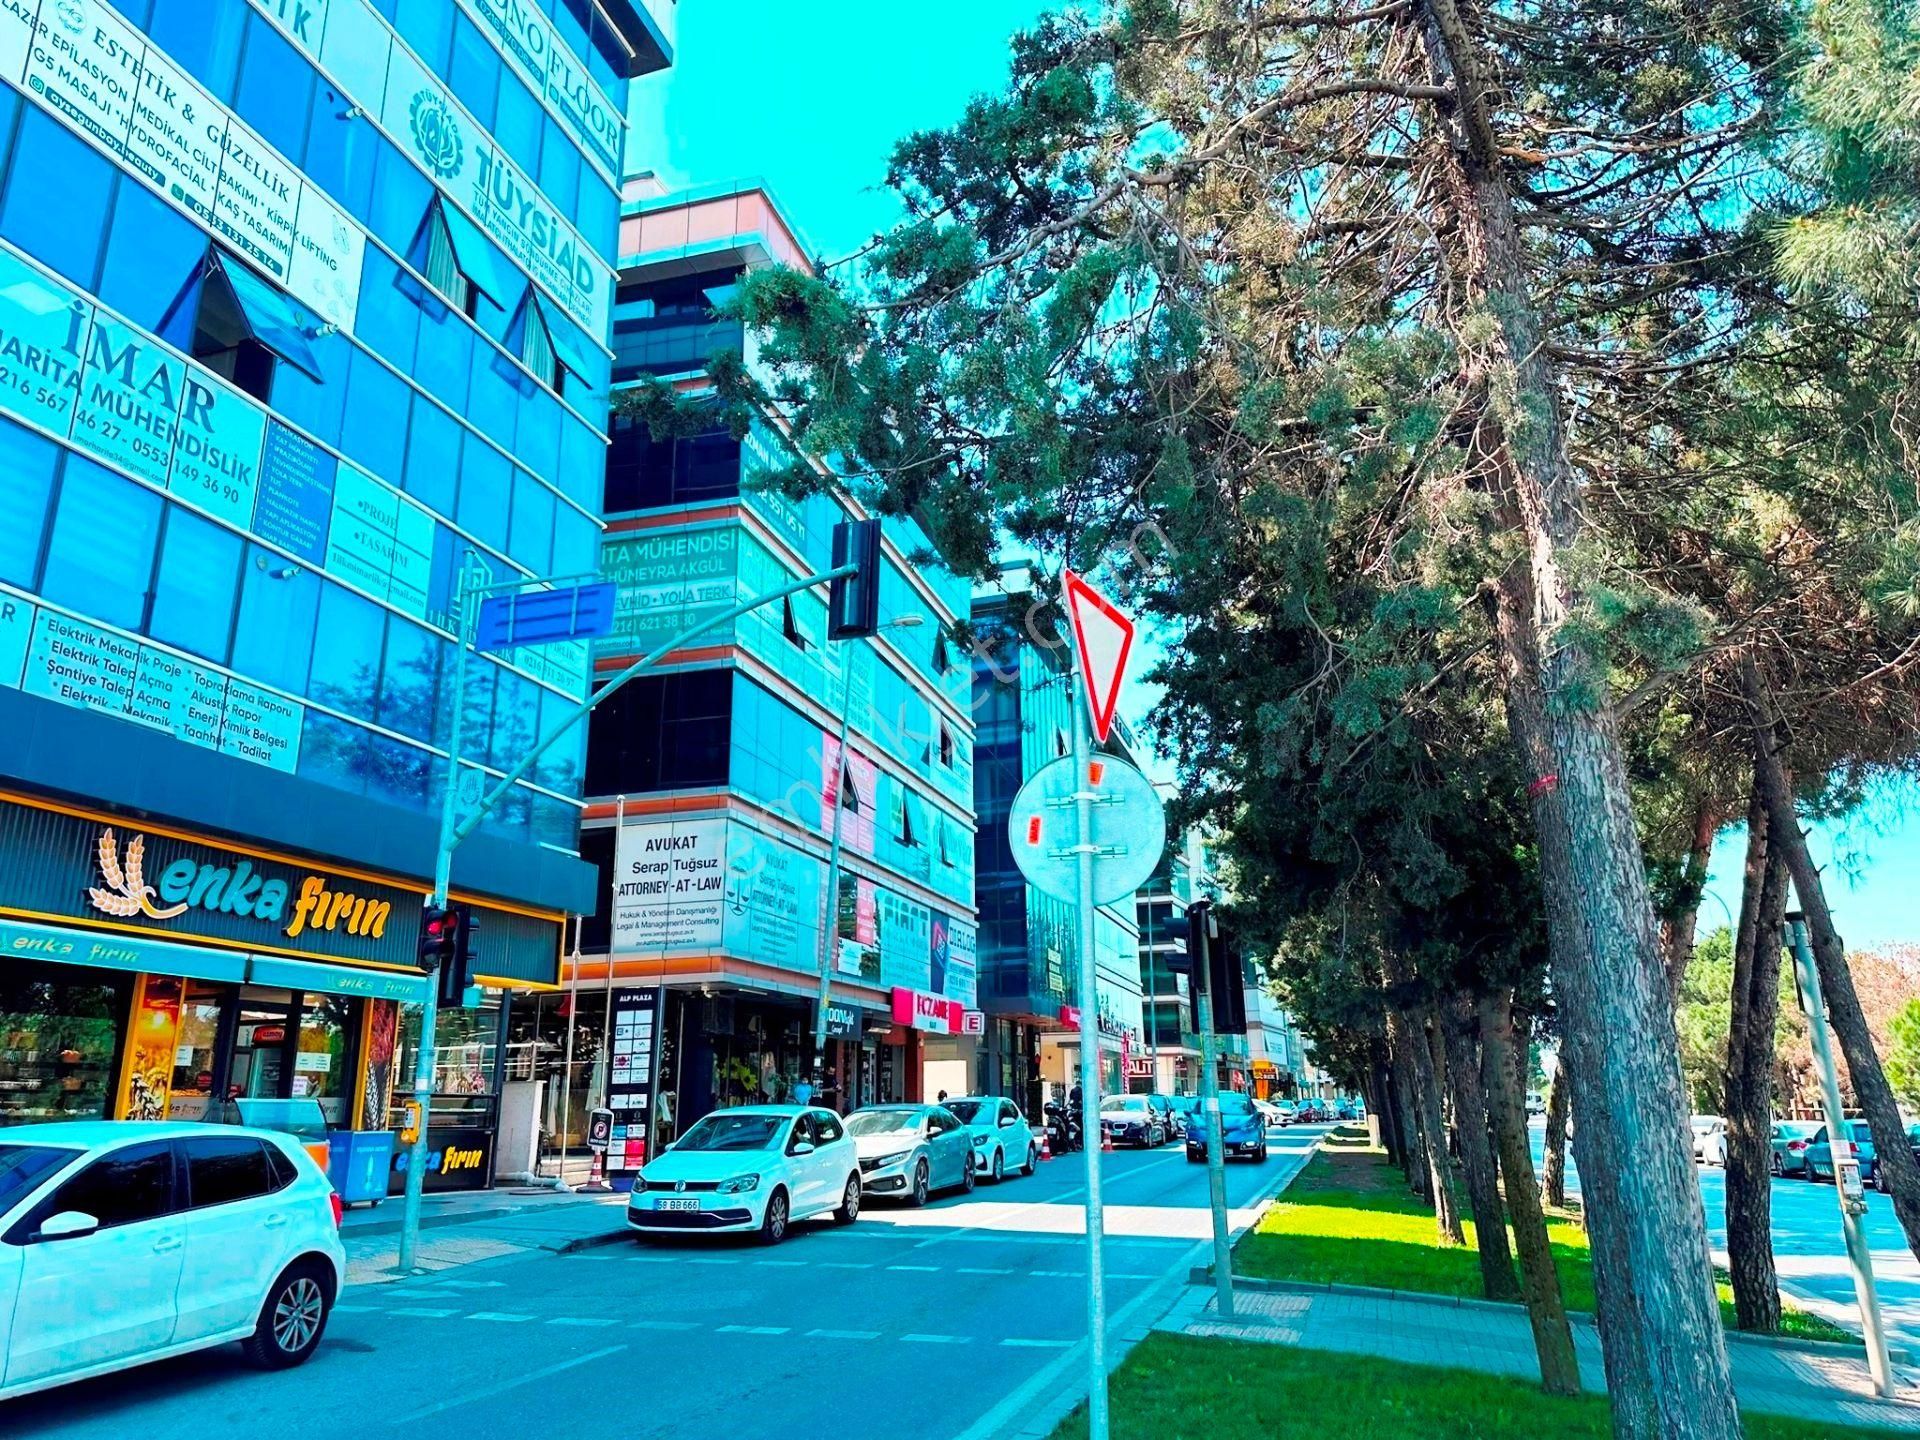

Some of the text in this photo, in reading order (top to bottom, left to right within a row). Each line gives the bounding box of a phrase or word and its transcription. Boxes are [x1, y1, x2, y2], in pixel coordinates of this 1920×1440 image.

[93, 26, 290, 203] ESTETİK & GÜZELLİK
[550, 47, 618, 153] FLOOR
[1, 0, 48, 39] LAZER
[52, 33, 128, 101] EPİLASYON
[136, 101, 190, 154] MEDİKAL
[193, 148, 218, 175] CİLT
[218, 170, 258, 207] BAKIMI
[267, 207, 300, 242] KİRPİK
[302, 235, 338, 271] LİFTİNG
[33, 47, 291, 257] G5 MASAJI HYDROFACİAL KAŞ TASARIMI
[475, 146, 594, 294] TÜYSİAD
[60, 299, 216, 434] İMAR
[36, 387, 68, 413] 567
[76, 410, 96, 431] 46
[100, 419, 121, 441] 27
[132, 437, 169, 467] 0553
[174, 459, 199, 482] 149
[203, 472, 218, 494] 36
[223, 482, 239, 503] 90
[91, 383, 251, 486] MÜHENDİSLİK
[635, 528, 736, 562] MÜHENDİSİ
[607, 557, 727, 584] HÜMEYRA AKGÜL
[660, 586, 695, 604] YOLA
[697, 585, 731, 600] TERK
[1, 603, 16, 622] R
[639, 616, 660, 630] 621
[664, 615, 679, 628] 38
[47, 619, 182, 677] Elektrik Mekanik Proje
[51, 641, 173, 693] Elektrik Talep Açma
[47, 660, 171, 710] Şantiye Talep Açma
[194, 671, 292, 717] Topraklama Raporu
[60, 685, 109, 706] Elektrik
[122, 704, 172, 728] Mekanik
[183, 723, 228, 748] Taahhüt
[238, 741, 272, 762] Tadilat
[190, 690, 262, 724] Akustik Rapor
[188, 707, 288, 750] Enerji Kimlik Belgesi
[645, 835, 698, 852] AVUKAT
[632, 857, 718, 875] Serap Tuğsuz
[160, 859, 391, 939] enka fırın
[620, 909, 640, 919] Hukuk
[641, 908, 647, 917] &
[616, 917, 720, 931] Legal & Management Consulting
[12, 935, 74, 955] enka
[619, 994, 653, 1003] ALP PLAZA
[917, 993, 949, 1020] ECZANE
[969, 1017, 979, 1030] E
[441, 1146, 483, 1175] fırın
[683, 1200, 698, 1209] 666
